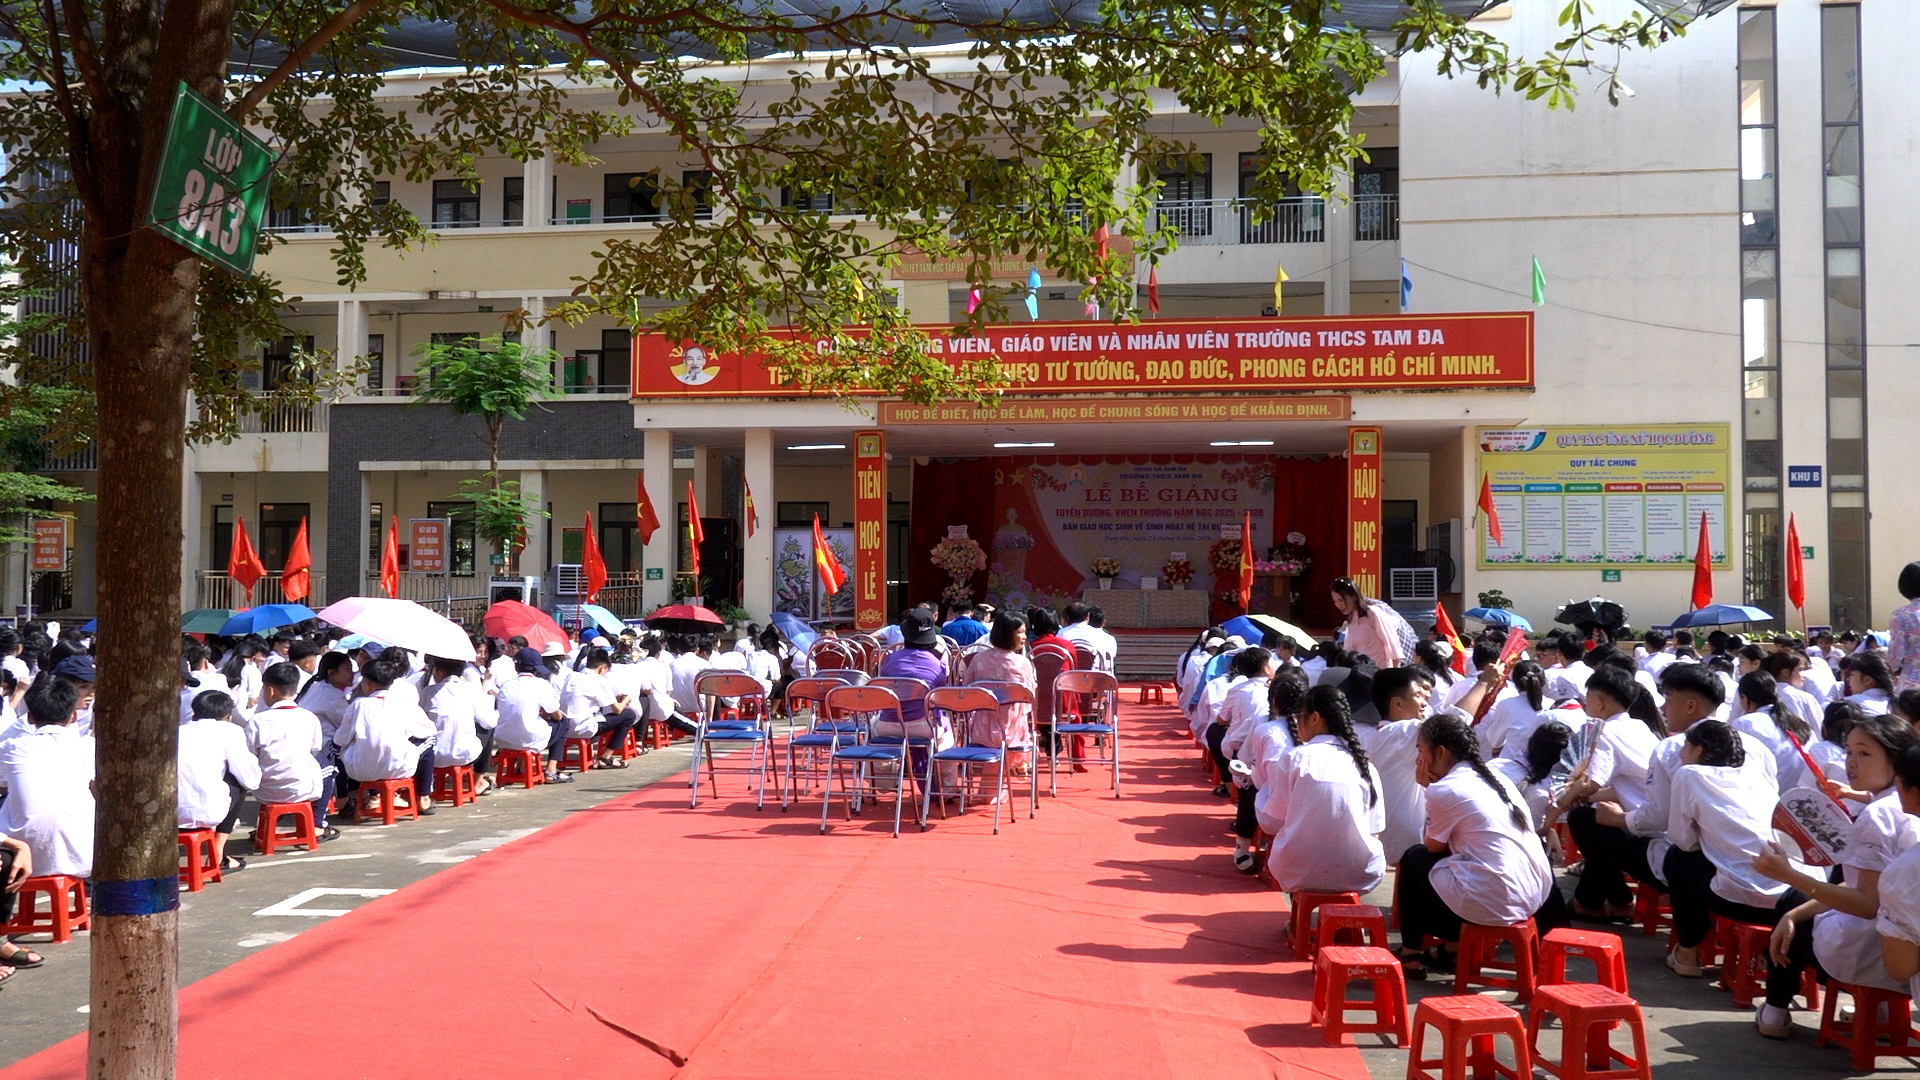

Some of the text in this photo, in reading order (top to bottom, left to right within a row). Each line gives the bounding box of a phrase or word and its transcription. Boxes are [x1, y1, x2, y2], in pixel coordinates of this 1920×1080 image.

[205, 128, 242, 173] LỚP
[178, 169, 245, 255] 8A3
[1002, 333, 1045, 353] GIÁO
[1049, 331, 1092, 352] VIÊN
[1097, 331, 1122, 351] VÀ
[1127, 329, 1180, 350] NHÂN
[1186, 329, 1230, 350] VIÊN
[1235, 327, 1311, 348] TRƯỜNG
[1316, 330, 1366, 347] THCS
[1371, 329, 1412, 346] TAM
[1416, 328, 1445, 346] ĐA
[995, 361, 1040, 383] THEO
[1046, 360, 1070, 382] TƯ
[1074, 355, 1140, 384] TƯỞNG,
[1145, 360, 1184, 384] ĐẠO
[1189, 355, 1235, 383] ĐỨC,
[1240, 357, 1306, 379] PHONG
[1312, 352, 1364, 378] CÁCH
[1370, 348, 1396, 377] HỒ
[1402, 351, 1436, 377] CHÍ
[1441, 354, 1501, 376] MINH.
[896, 400, 1331, 422] HỌC ĐỂ BIẾT, HỌC ĐỂ LÀM, HỌC ĐỂ CHUNG SỐNG VÀ HỌC ĐỂ KHẲNG ĐỊNH.
[1557, 434, 1579, 449] QUY
[1570, 457, 1637, 468] QUY TẮC CHUNG
[1790, 471, 1820, 482] KHU B
[858, 464, 881, 499] TIÊN
[1084, 480, 1238, 502] LỄ BẾ GIẢNG
[1353, 462, 1377, 506] HẬU
[1079, 522, 1097, 531] GIAO
[1098, 522, 1113, 533] HỌC
[1114, 522, 1133, 531] SINH
[1145, 522, 1163, 531] SINH
[1164, 522, 1184, 533] HOẠT
[1114, 508, 1137, 518] KHEN
[1173, 506, 1193, 518] NĂM
[1194, 508, 1211, 520] HỌC
[1214, 508, 1235, 518] 2025
[859, 520, 880, 556] HỌC
[1353, 521, 1376, 558] HỌC
[864, 560, 877, 600] LỄ
[1353, 567, 1376, 599] VĂN
